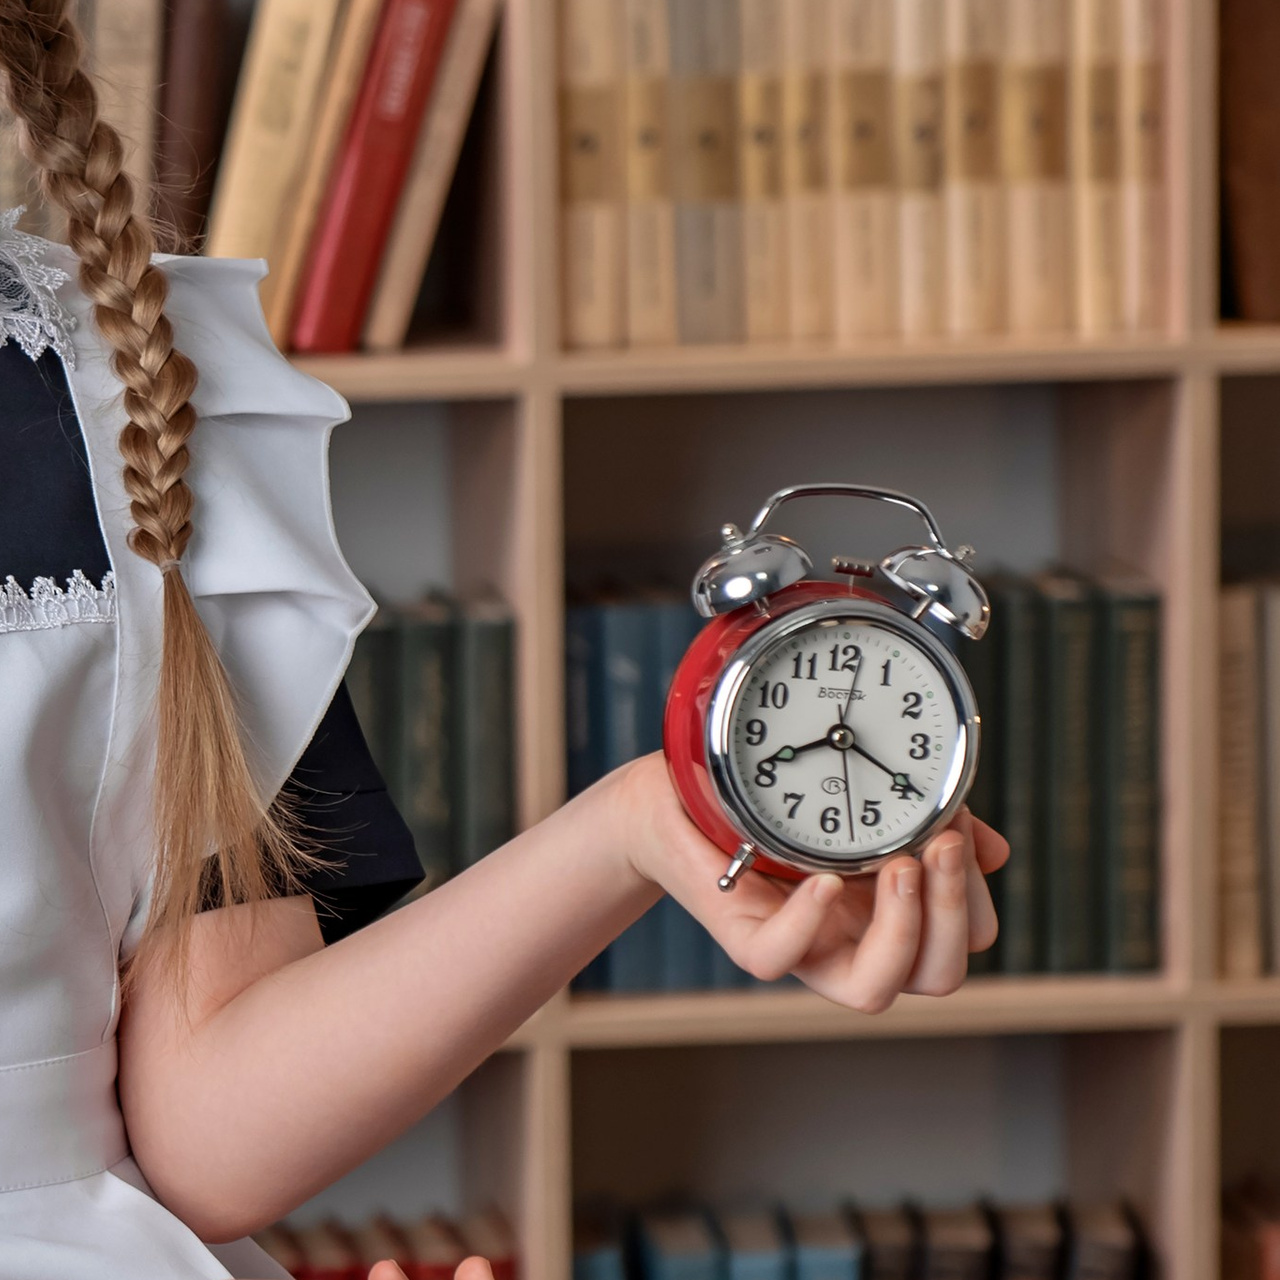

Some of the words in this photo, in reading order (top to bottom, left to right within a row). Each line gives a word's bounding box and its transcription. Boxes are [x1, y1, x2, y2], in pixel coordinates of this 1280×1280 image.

[791, 651, 818, 680] 11
[828, 644, 862, 673] 12
[880, 659, 892, 686] 1
[758, 680, 789, 709] 10
[901, 692, 923, 720] 2
[746, 719, 768, 746] 9
[909, 733, 931, 760] 3
[754, 760, 777, 788] 8
[783, 792, 806, 820] 7
[860, 799, 882, 827] 5
[820, 807, 841, 834] 6
